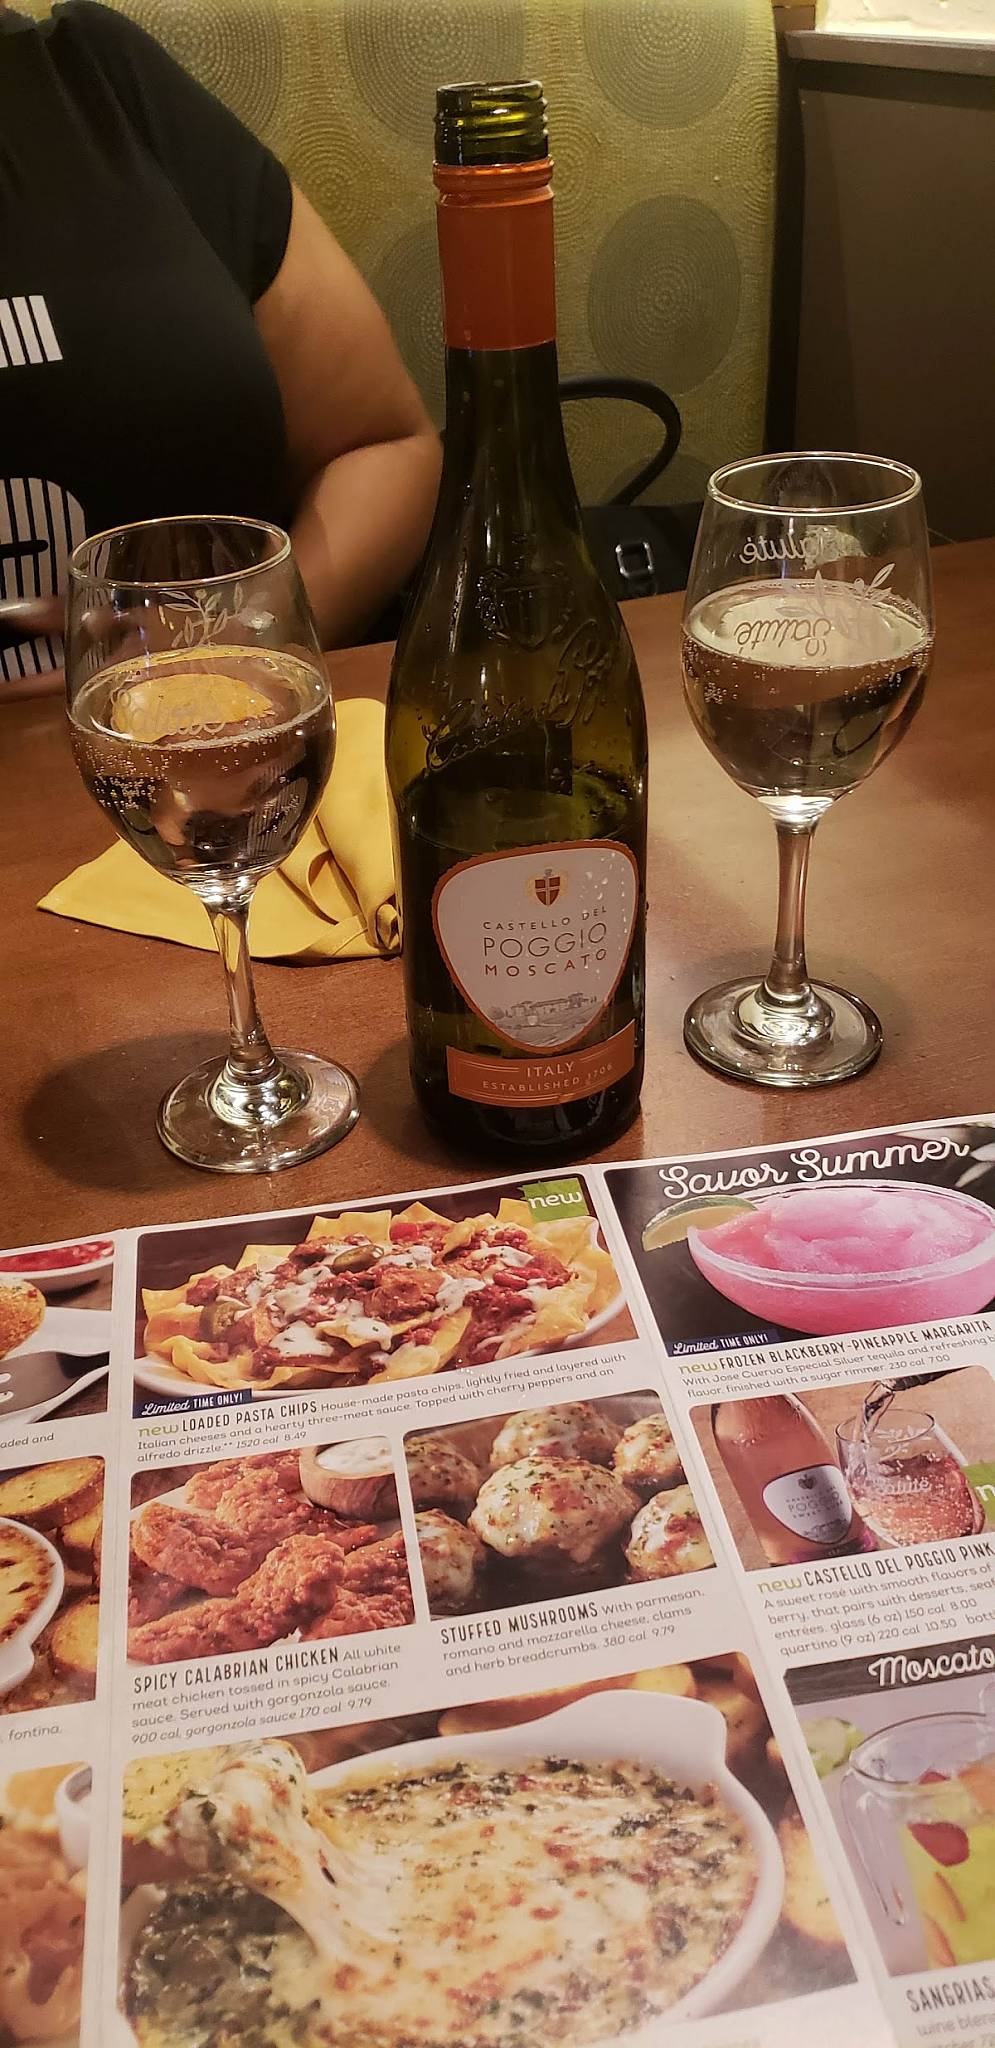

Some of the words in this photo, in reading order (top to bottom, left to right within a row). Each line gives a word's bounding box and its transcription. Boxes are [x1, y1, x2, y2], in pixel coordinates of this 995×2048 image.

[483, 917, 570, 931] CASTELLO
[582, 906, 607, 920] DEL
[484, 922, 607, 958] POGGIO
[485, 948, 607, 977] MOSCATO
[482, 1076, 580, 1092] ESTABLISHED
[527, 1061, 574, 1077] ITALY
[659, 1161, 789, 1200] Savor
[789, 1136, 970, 1182] Summer
[529, 1188, 584, 1210] new
[673, 1340, 719, 1354] Limited
[720, 1335, 742, 1348] TIME
[743, 1334, 768, 1346] ONLY!
[678, 1361, 719, 1375] new
[719, 1352, 765, 1370] FROZEN
[770, 1331, 919, 1362] BLACKBERRY-PINEAPPLE
[921, 1320, 992, 1341] MARGARITA
[683, 1375, 710, 1386] With
[711, 1372, 740, 1384] Jose
[742, 1368, 784, 1380] Cuervo
[786, 1359, 831, 1376] Especial
[833, 1355, 864, 1366] Silver
[867, 1349, 905, 1364] tequila
[907, 1344, 929, 1355] and
[930, 1336, 987, 1354] refreshing
[726, 1380, 770, 1393] finished
[772, 1376, 798, 1388] with
[800, 1375, 808, 1383] a
[810, 1371, 842, 1384] sugar
[889, 1361, 907, 1371] 230
[909, 1358, 925, 1367] cal
[138, 1423, 178, 1437] new
[182, 1414, 230, 1432] LOADED
[236, 1408, 275, 1425] PASTA
[280, 1401, 317, 1418] CHIPS
[321, 1394, 394, 1412] House-made
[396, 1388, 429, 1402] pasta
[466, 1374, 501, 1390] lightly
[504, 1368, 530, 1381] fried
[533, 1363, 554, 1376] and
[556, 1358, 598, 1374] layered
[600, 1353, 626, 1366] with
[138, 1438, 176, 1451] Italian
[179, 1432, 226, 1446] cheeses
[230, 1427, 252, 1439] and
[255, 1425, 262, 1434] a
[265, 1419, 305, 1435] hearty
[308, 1409, 374, 1427] three-meat
[416, 1394, 457, 1410] Topped
[458, 1389, 485, 1402] with
[487, 1383, 525, 1396] cherry
[527, 1376, 573, 1392] peppers
[575, 1370, 597, 1382] and
[599, 1368, 614, 1379] an
[141, 1400, 192, 1416] Limited
[193, 1397, 214, 1409] TIME
[217, 1392, 243, 1407] ONLY!
[32, 1432, 54, 1443] and
[138, 1450, 180, 1462] alfredo
[236, 1437, 261, 1450] 1520
[262, 1435, 278, 1446] cal
[284, 1431, 307, 1443] 8.49
[757, 1577, 802, 1594] new
[804, 1562, 872, 1586] CASTELLO
[875, 1557, 902, 1575] DEL
[905, 1548, 956, 1570] POGGIO
[959, 1542, 995, 1560] PINK
[764, 1599, 774, 1609] A
[776, 1594, 816, 1608] sweet
[849, 1583, 878, 1595] with
[880, 1574, 929, 1589] smooth
[930, 1566, 977, 1581] flavors
[979, 1563, 992, 1573] of
[441, 1620, 501, 1645] STUFFED
[508, 1602, 598, 1633] MUSHROOMS
[601, 1601, 633, 1615] With
[811, 1605, 840, 1617] that
[842, 1600, 875, 1616] pairs
[877, 1594, 907, 1607] with
[831, 1618, 866, 1634] glass
[883, 1610, 902, 1623] oz)
[905, 1607, 924, 1619] 150
[927, 1604, 945, 1615] cal
[443, 1645, 495, 1661] romano
[498, 1637, 523, 1651] and
[527, 1625, 597, 1646] mozzarella
[652, 1607, 692, 1621] clams
[780, 1639, 838, 1657] quartino
[856, 1632, 876, 1644] oz)
[878, 1628, 899, 1640] 220
[902, 1624, 920, 1636] cal
[134, 1672, 177, 1694] SPICY
[185, 1658, 268, 1686] CALABRIAN
[275, 1646, 339, 1672] CHICKEN
[343, 1649, 361, 1661] All
[364, 1644, 401, 1658] white
[446, 1664, 471, 1677] and
[474, 1657, 505, 1671] herb
[603, 1635, 626, 1648] 380
[628, 1631, 646, 1643] cal
[868, 1644, 995, 1686] Moscato
[132, 1697, 168, 1710] meat
[171, 1689, 225, 1705] chicken
[229, 1680, 274, 1697] tossed
[277, 1678, 289, 1688] in
[293, 1672, 329, 1687] spicy
[332, 1661, 399, 1680] Calabrian
[180, 1703, 229, 1720] Served
[233, 1698, 263, 1711] with
[267, 1686, 344, 1709] gorgonzola
[131, 1731, 157, 1744] 900
[186, 1717, 256, 1738] gorgonzola
[259, 1711, 296, 1725] sauce
[300, 1706, 320, 1719] 170
[322, 1702, 341, 1713] cal
[906, 1976, 995, 2012] SANGRIAS
